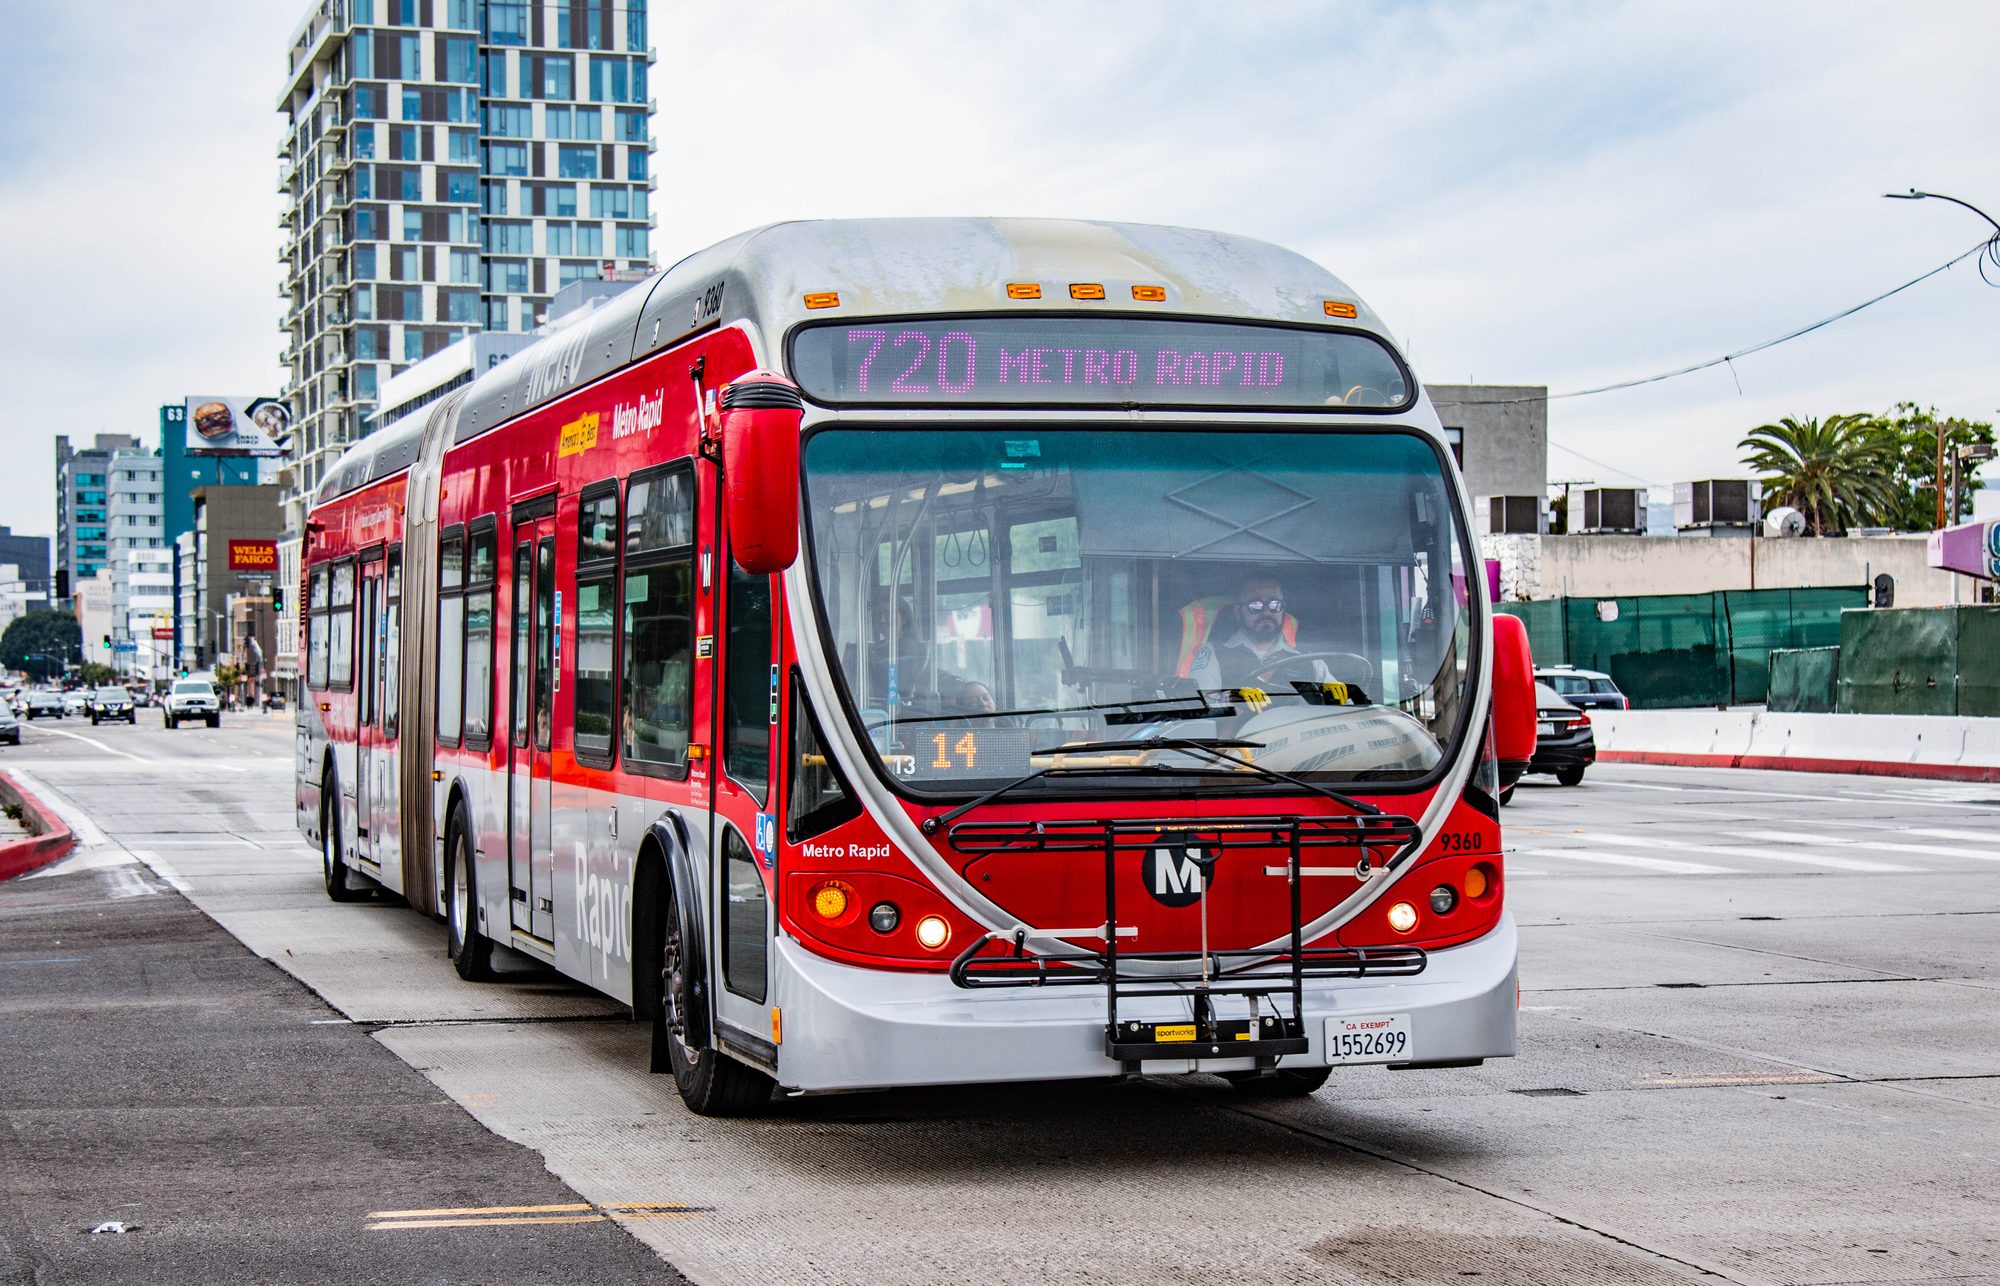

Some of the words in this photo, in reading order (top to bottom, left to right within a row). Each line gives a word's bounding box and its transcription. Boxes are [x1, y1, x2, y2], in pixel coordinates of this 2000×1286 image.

[703, 281, 724, 318] 9360
[848, 330, 977, 393] 720
[1000, 348, 1138, 384] METRO
[1156, 351, 1284, 386] RAPID
[167, 407, 187, 421] 63
[612, 402, 637, 440] Metro
[638, 388, 664, 439] Rapid
[233, 546, 274, 555] WELLS
[234, 555, 274, 564] FARGO
[933, 732, 976, 768] 14
[802, 843, 845, 857] Metro
[849, 843, 890, 860] Rapid
[1441, 831, 1482, 851] 9360
[1155, 848, 1202, 895] M
[575, 840, 632, 980] Rapid
[1156, 1029, 1195, 1037] sportworks
[1346, 1023, 1357, 1031] CA
[1360, 1021, 1391, 1030] EXEMPT
[1332, 1031, 1406, 1057] 1552699
